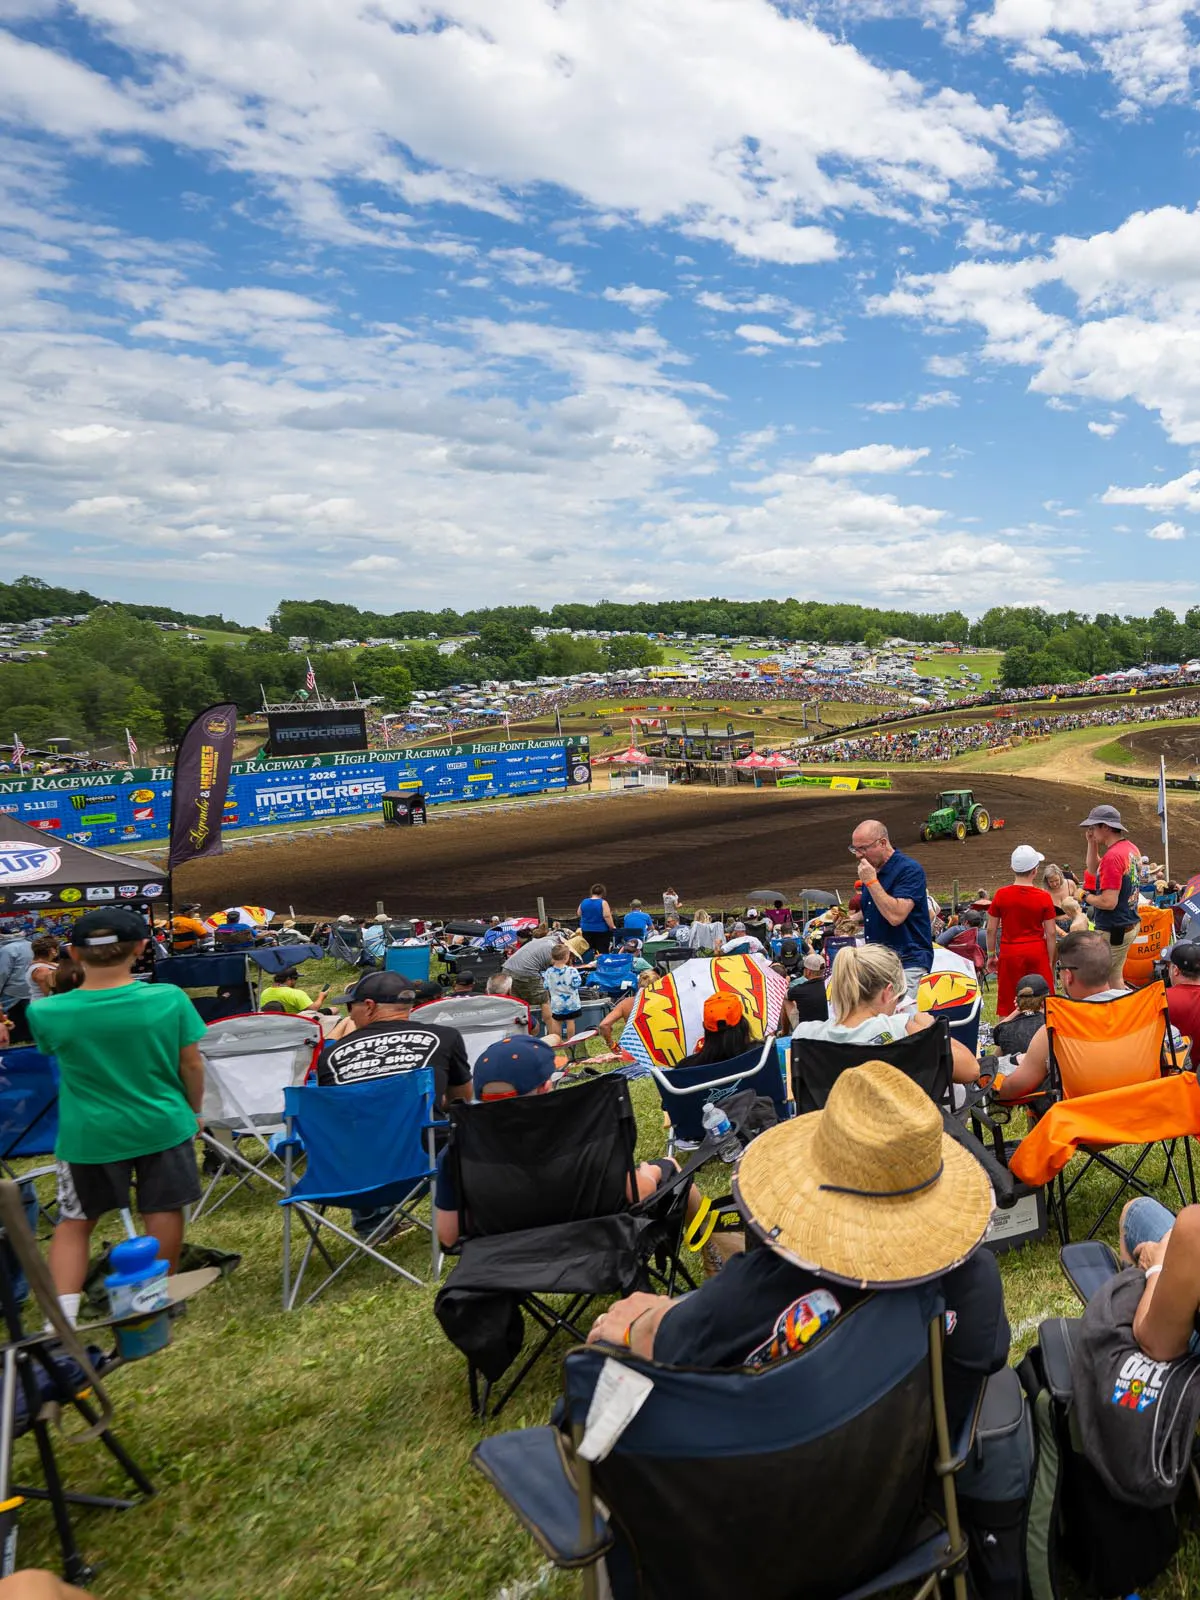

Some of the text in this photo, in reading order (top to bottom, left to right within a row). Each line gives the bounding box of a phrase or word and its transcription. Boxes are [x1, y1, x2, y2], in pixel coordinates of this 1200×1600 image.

[276, 727, 361, 741] MOTOCROSS
[472, 739, 565, 754] HIGH POINT RACEWAY
[334, 748, 452, 765] HIGH POINT RACEWAY
[246, 759, 308, 773] RACEWAY
[151, 767, 174, 781] HI
[309, 771, 337, 781] 2026
[30, 774, 116, 791] RACEWAY
[189, 745, 215, 850] Legends & HEROES
[255, 781, 386, 807] MOTOCROSS
[24, 802, 47, 811] 5.11
[1184, 899, 1200, 915] USA
[1138, 923, 1155, 933] ADY
[1150, 931, 1161, 940] TO
[1137, 942, 1161, 954] RACE
[334, 1034, 435, 1060] FASTHOUSE
[339, 1058, 381, 1075] SPEED
[385, 1054, 424, 1064] SHOP
